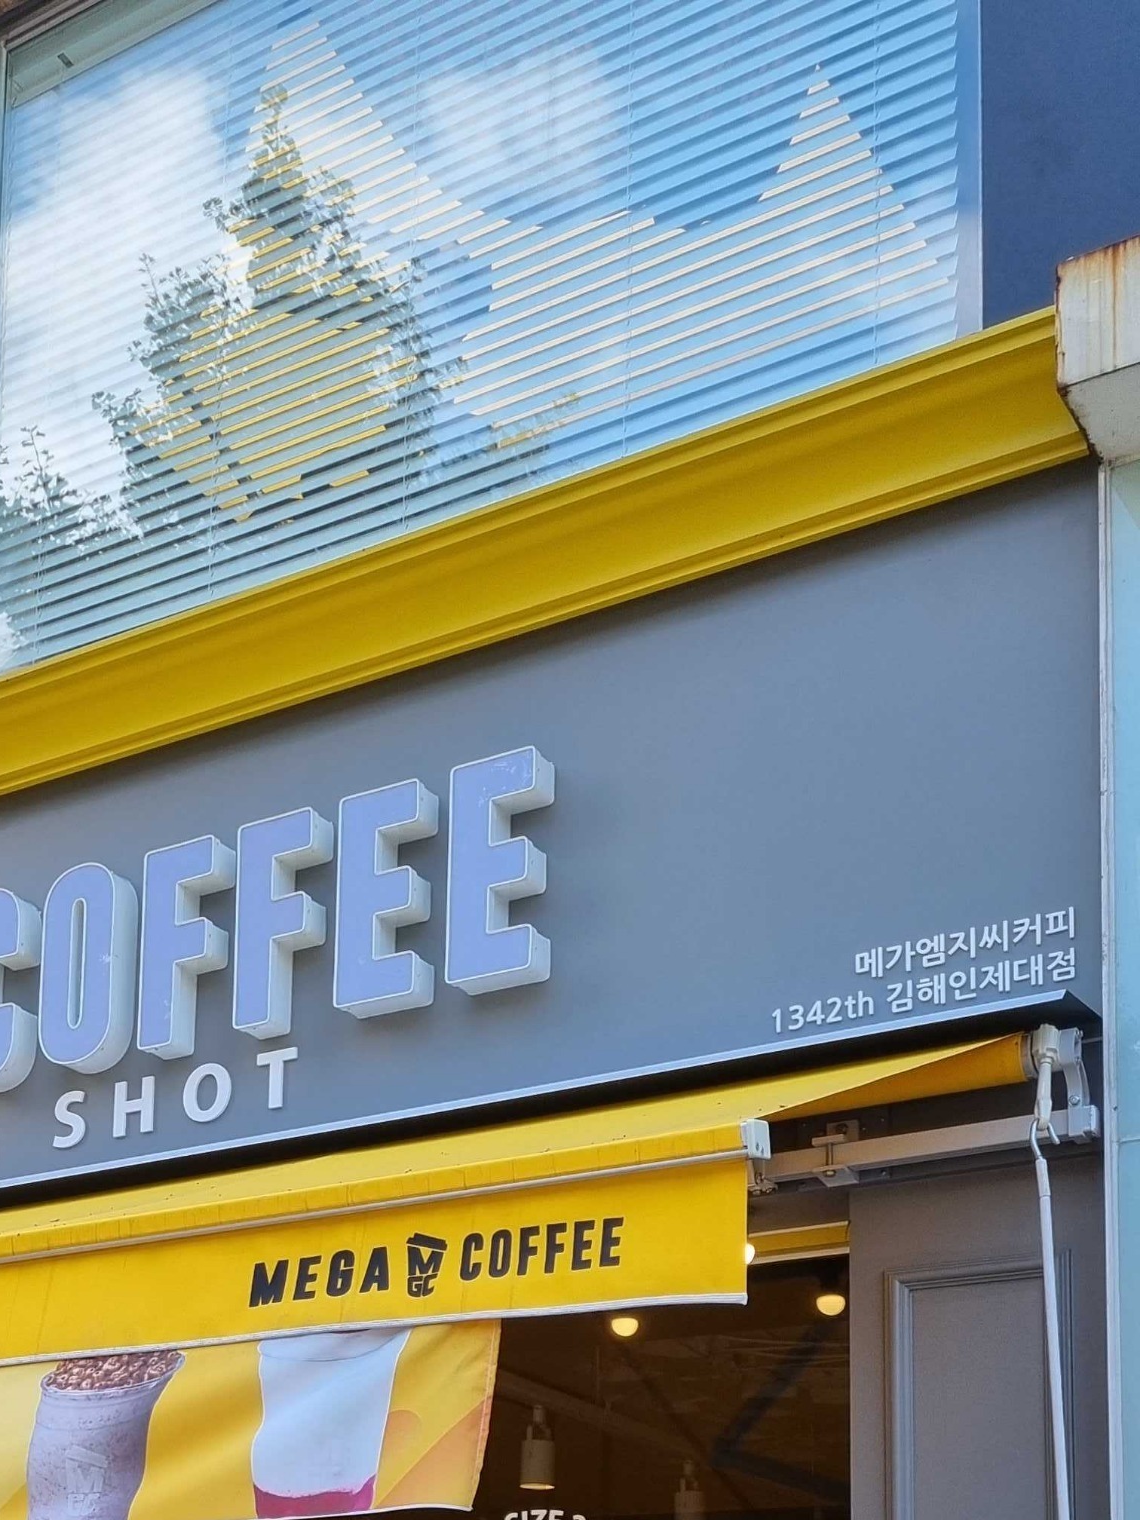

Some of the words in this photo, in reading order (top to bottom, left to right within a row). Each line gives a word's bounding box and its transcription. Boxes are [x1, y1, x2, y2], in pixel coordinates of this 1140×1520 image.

[855, 906, 1076, 979] 메가엠지씨커피
[771, 991, 875, 1034] 1342th
[886, 947, 1077, 1013] 김해인제대점
[52, 1046, 298, 1150] SHOT
[249, 1247, 390, 1308] MEGA
[459, 1216, 625, 1282] COFFEE
